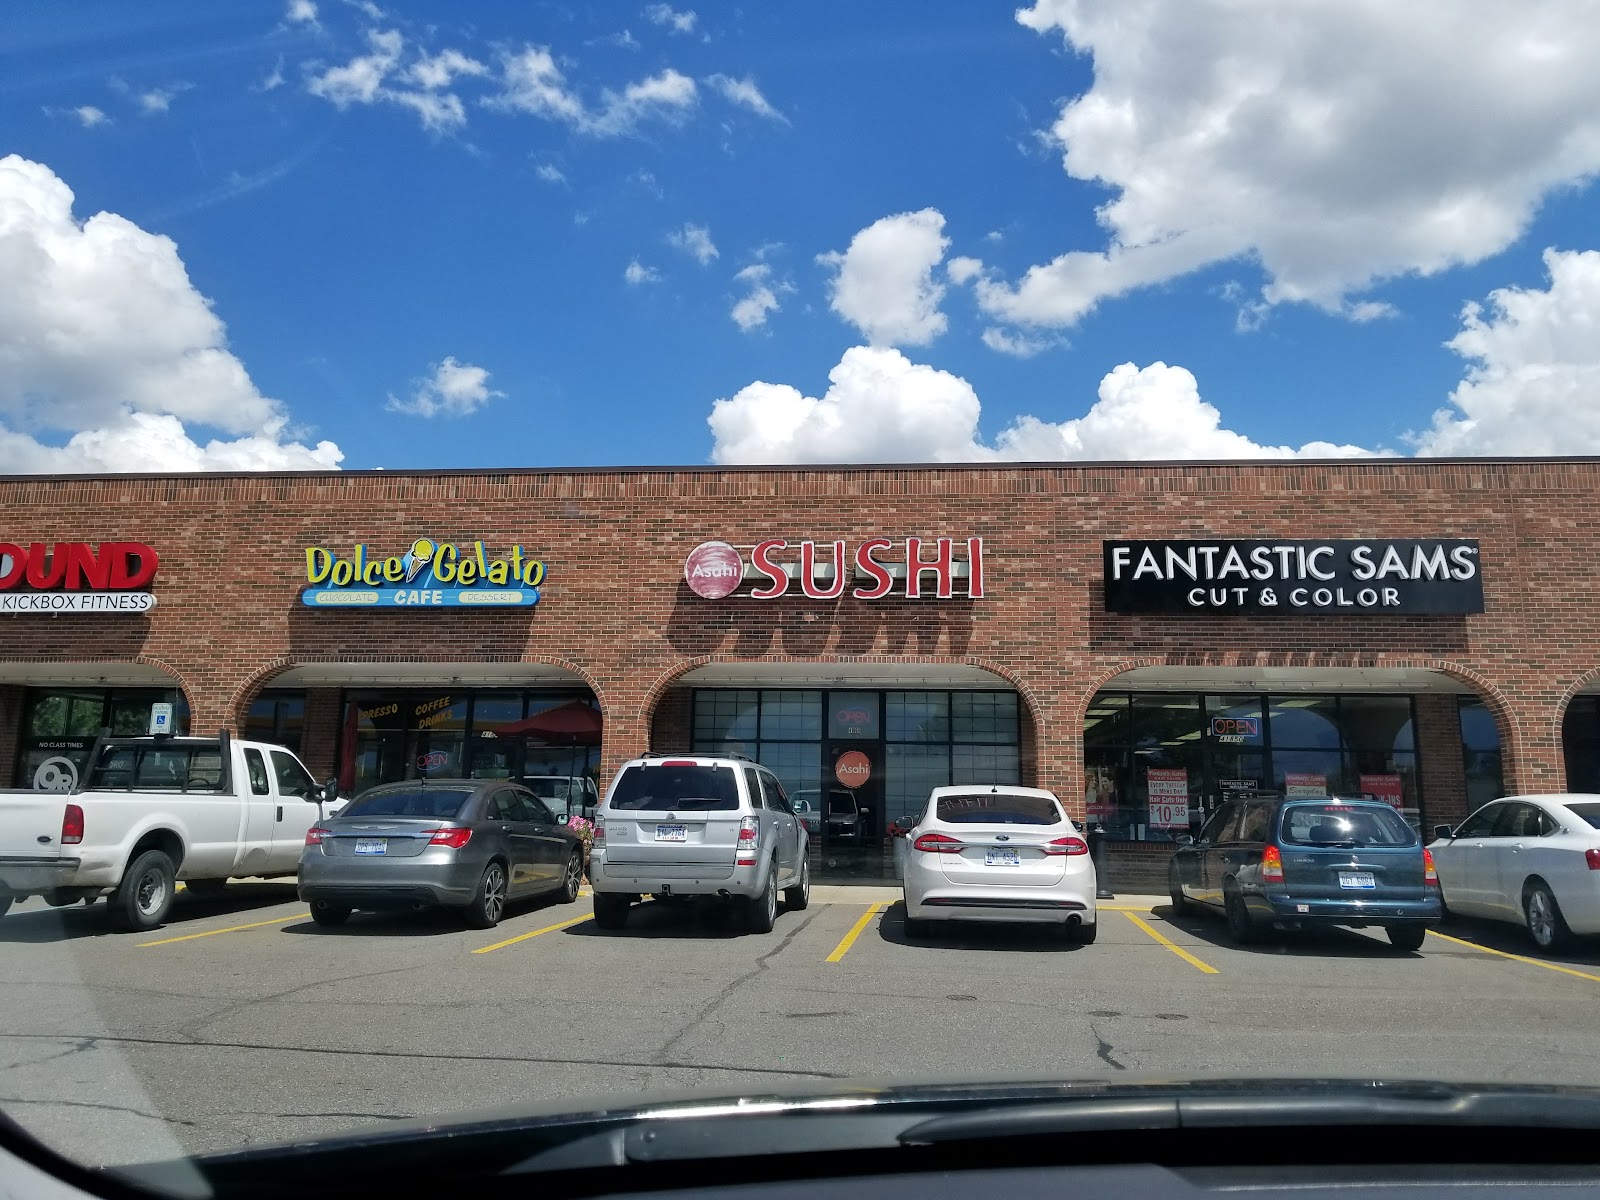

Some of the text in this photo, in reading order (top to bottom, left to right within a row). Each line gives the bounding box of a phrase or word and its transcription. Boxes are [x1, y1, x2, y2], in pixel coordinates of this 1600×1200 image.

[304, 540, 547, 586] Dolce Gelato
[691, 562, 738, 578] Asahi
[750, 537, 985, 599] SUSHI
[1111, 544, 1477, 581] FANTASTIC SAMS
[1, 594, 149, 609] KICKBOX FITNESS
[319, 593, 374, 602] CHOCOLATE
[394, 590, 443, 605] CAFE
[467, 593, 515, 602] DESSERT
[1187, 587, 1401, 606] CUT & COLOR
[415, 696, 450, 716] COFFEE
[418, 709, 453, 729] DRINKS
[837, 710, 870, 723] OPEN
[1215, 719, 1256, 734] OPEN
[416, 754, 448, 767] OPEN
[839, 763, 869, 774] Asahi
[1176, 796, 1188, 804] Only
